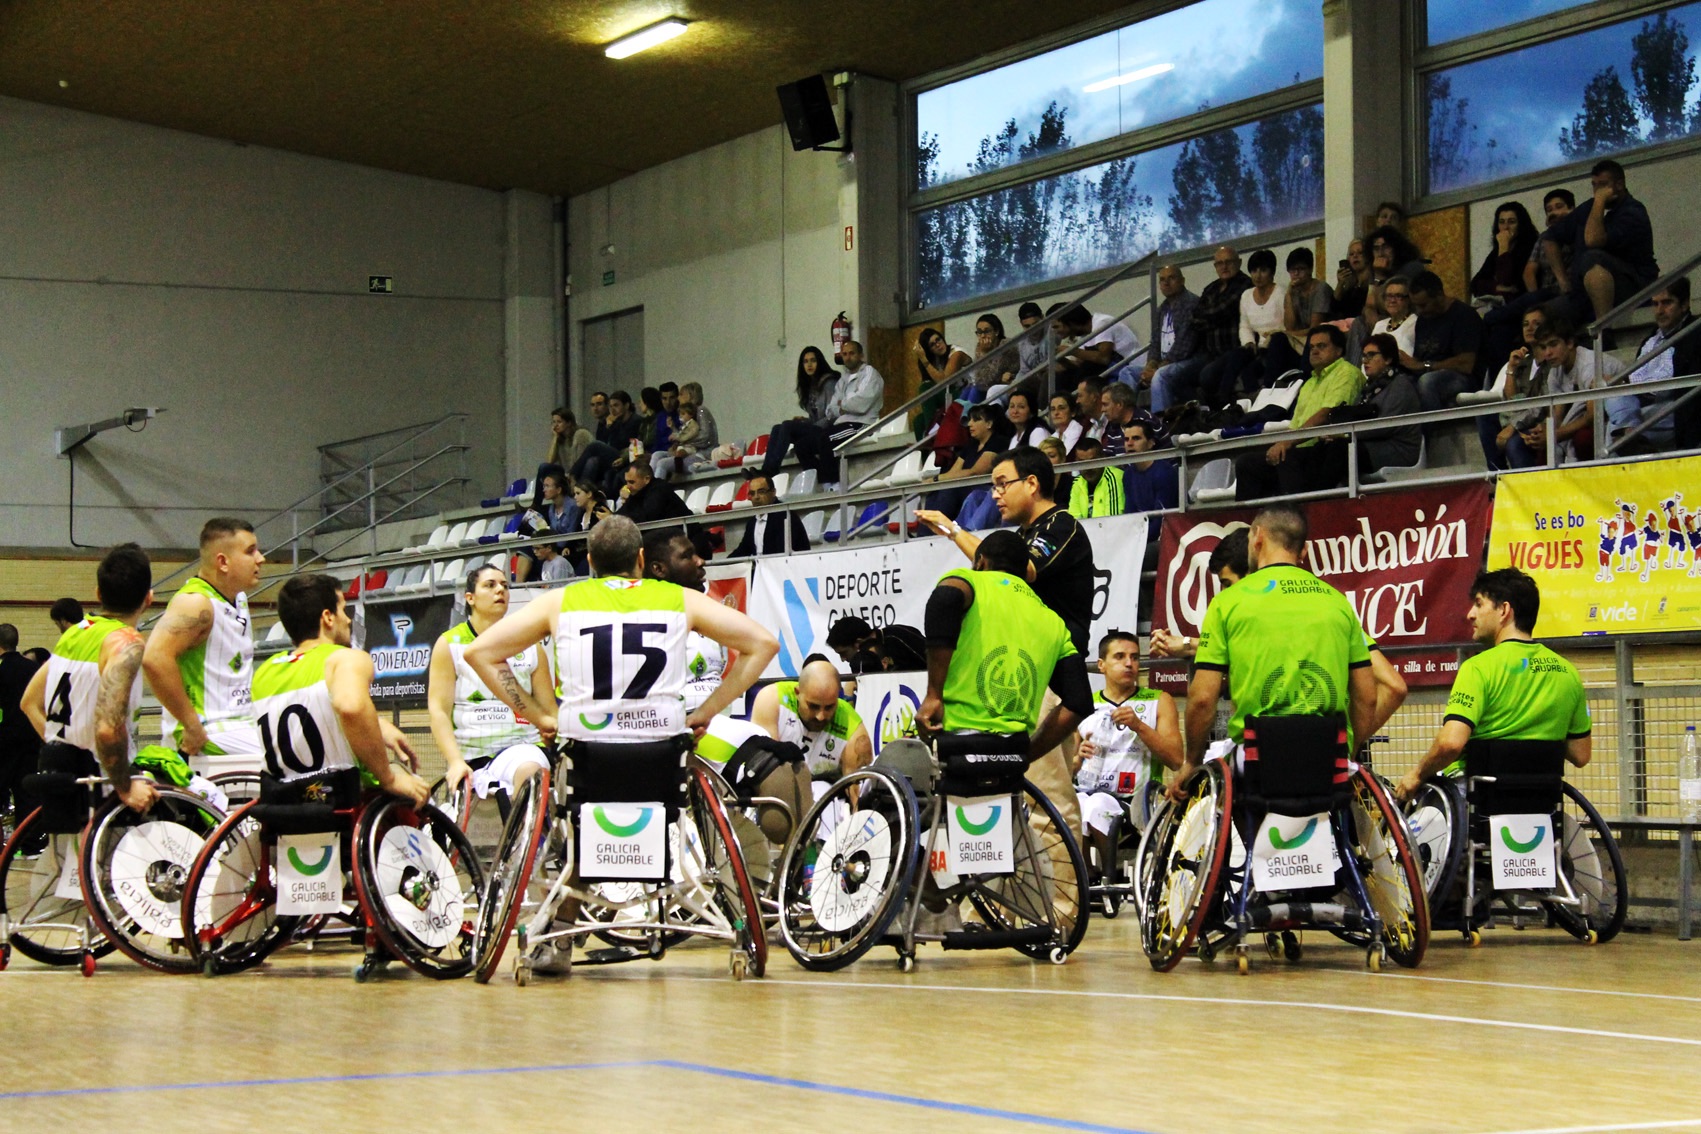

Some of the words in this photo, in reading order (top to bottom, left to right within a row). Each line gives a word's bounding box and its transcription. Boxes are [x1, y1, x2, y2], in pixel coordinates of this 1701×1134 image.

[1535, 512, 1547, 530] Se
[1551, 515, 1564, 529] es
[1568, 510, 1585, 528] bo
[1304, 504, 1469, 577] undación
[1509, 531, 1584, 570] VIGUÉS
[825, 568, 903, 601] DEPORTE
[1279, 579, 1320, 588] GALICIA
[1281, 585, 1333, 596] SAUDABLE
[1600, 600, 1637, 621] vide
[371, 648, 430, 672] POWERADE
[579, 622, 668, 700] 15
[1529, 657, 1560, 666] GALICIA
[1404, 660, 1421, 673] silla
[1425, 660, 1437, 673] de
[1530, 664, 1569, 674] SAUDABLE
[370, 683, 382, 697] bida
[382, 685, 394, 699] para
[394, 682, 426, 698] deportistas
[46, 671, 72, 739] 4
[488, 713, 507, 721] VIGO
[616, 709, 657, 721] GALICIA
[617, 717, 669, 731] SAUDABLE
[257, 703, 325, 779] 10
[596, 843, 641, 854] GALICIA
[959, 841, 993, 852] GALICIA
[596, 854, 654, 866] SAUDABLE
[960, 851, 1004, 863] SAUDABLE
[1266, 854, 1309, 867] GALICIA
[1503, 858, 1537, 868] GALICIA
[1267, 863, 1324, 878] SAUDABLE
[1503, 867, 1547, 878] SAUDABLE
[291, 881, 327, 893] GALICIA
[291, 891, 336, 903] SAUDABLE
